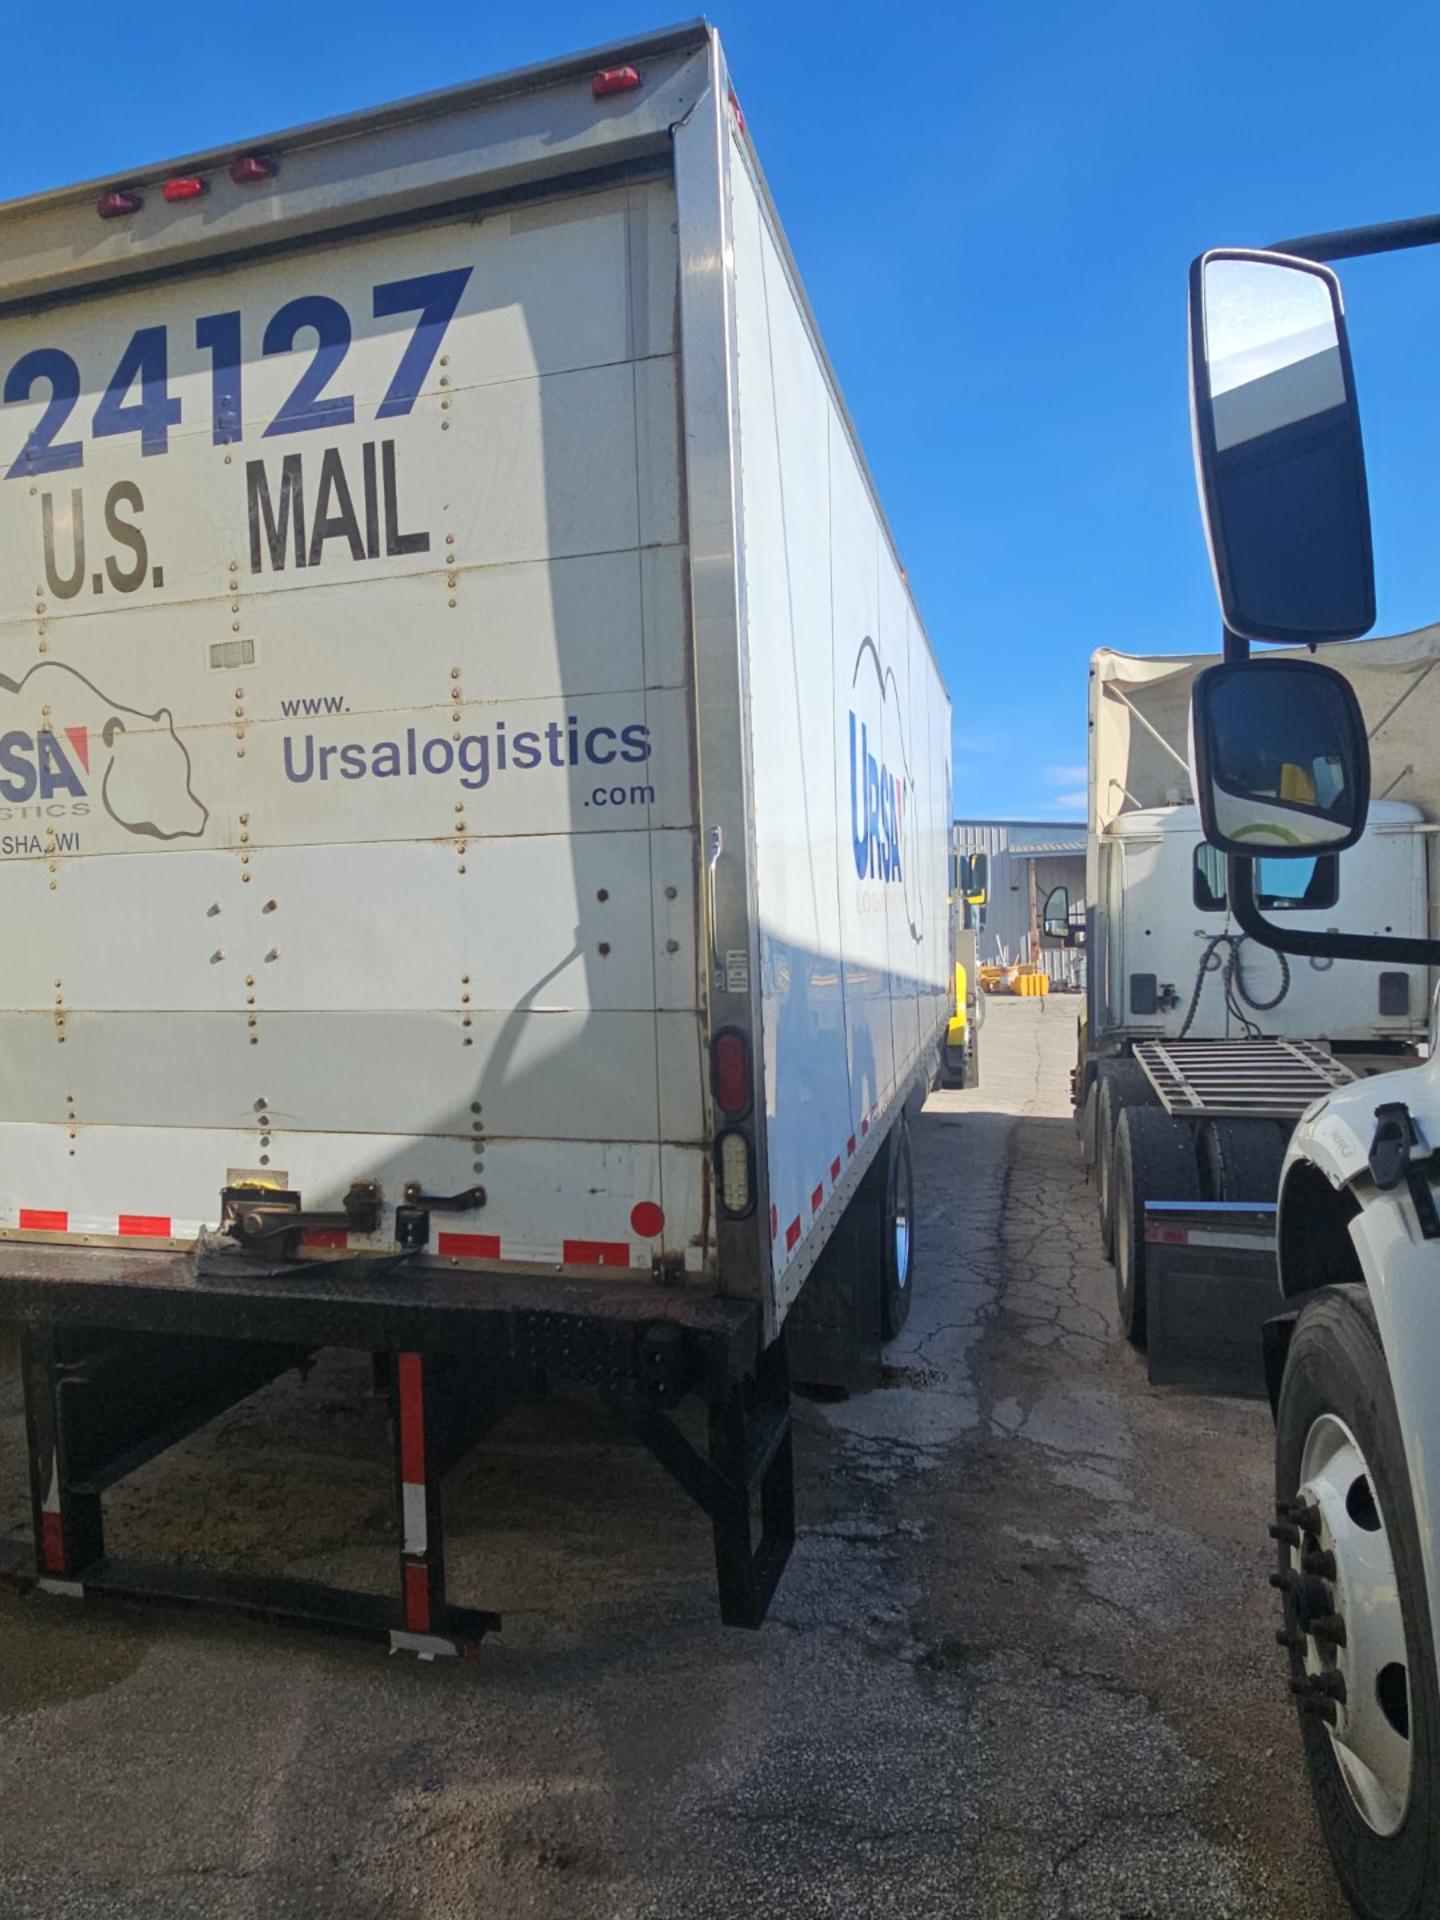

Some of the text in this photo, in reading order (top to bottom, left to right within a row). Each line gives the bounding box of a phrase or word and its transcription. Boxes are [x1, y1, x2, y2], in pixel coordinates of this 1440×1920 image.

[3, 266, 474, 481] 24127
[41, 439, 430, 600] U.S. MAIL
[280, 695, 351, 717] www.
[283, 715, 653, 790] Ursalogistics
[583, 784, 656, 807] .com
[849, 708, 902, 883] URSA
[55, 832, 79, 852] WI
